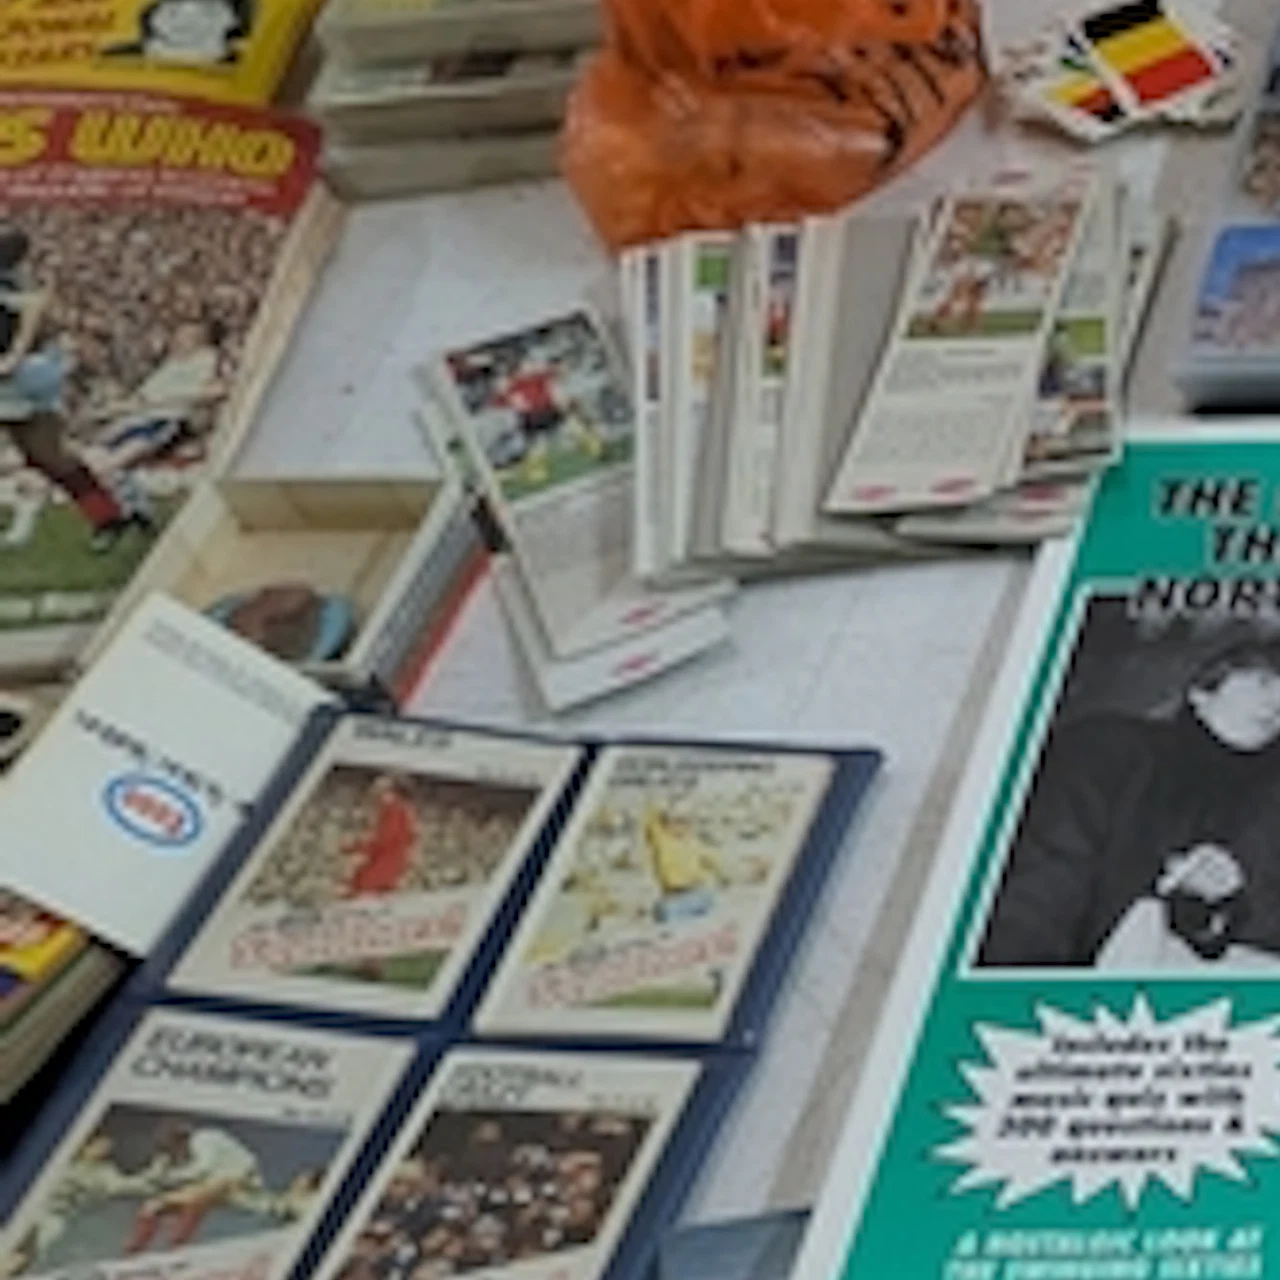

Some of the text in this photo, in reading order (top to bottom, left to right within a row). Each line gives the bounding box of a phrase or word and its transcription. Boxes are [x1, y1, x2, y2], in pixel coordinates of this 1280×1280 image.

[1156, 477, 1258, 516] THE
[146, 1029, 338, 1071] EUROPEAN
[130, 1053, 335, 1100] CHAMPIONS
[1014, 1057, 1254, 1083] ultimate sixties
[1011, 1085, 1246, 1115] music quiz with
[1065, 1116, 1214, 1140] questions
[1049, 1145, 1178, 1166] answers
